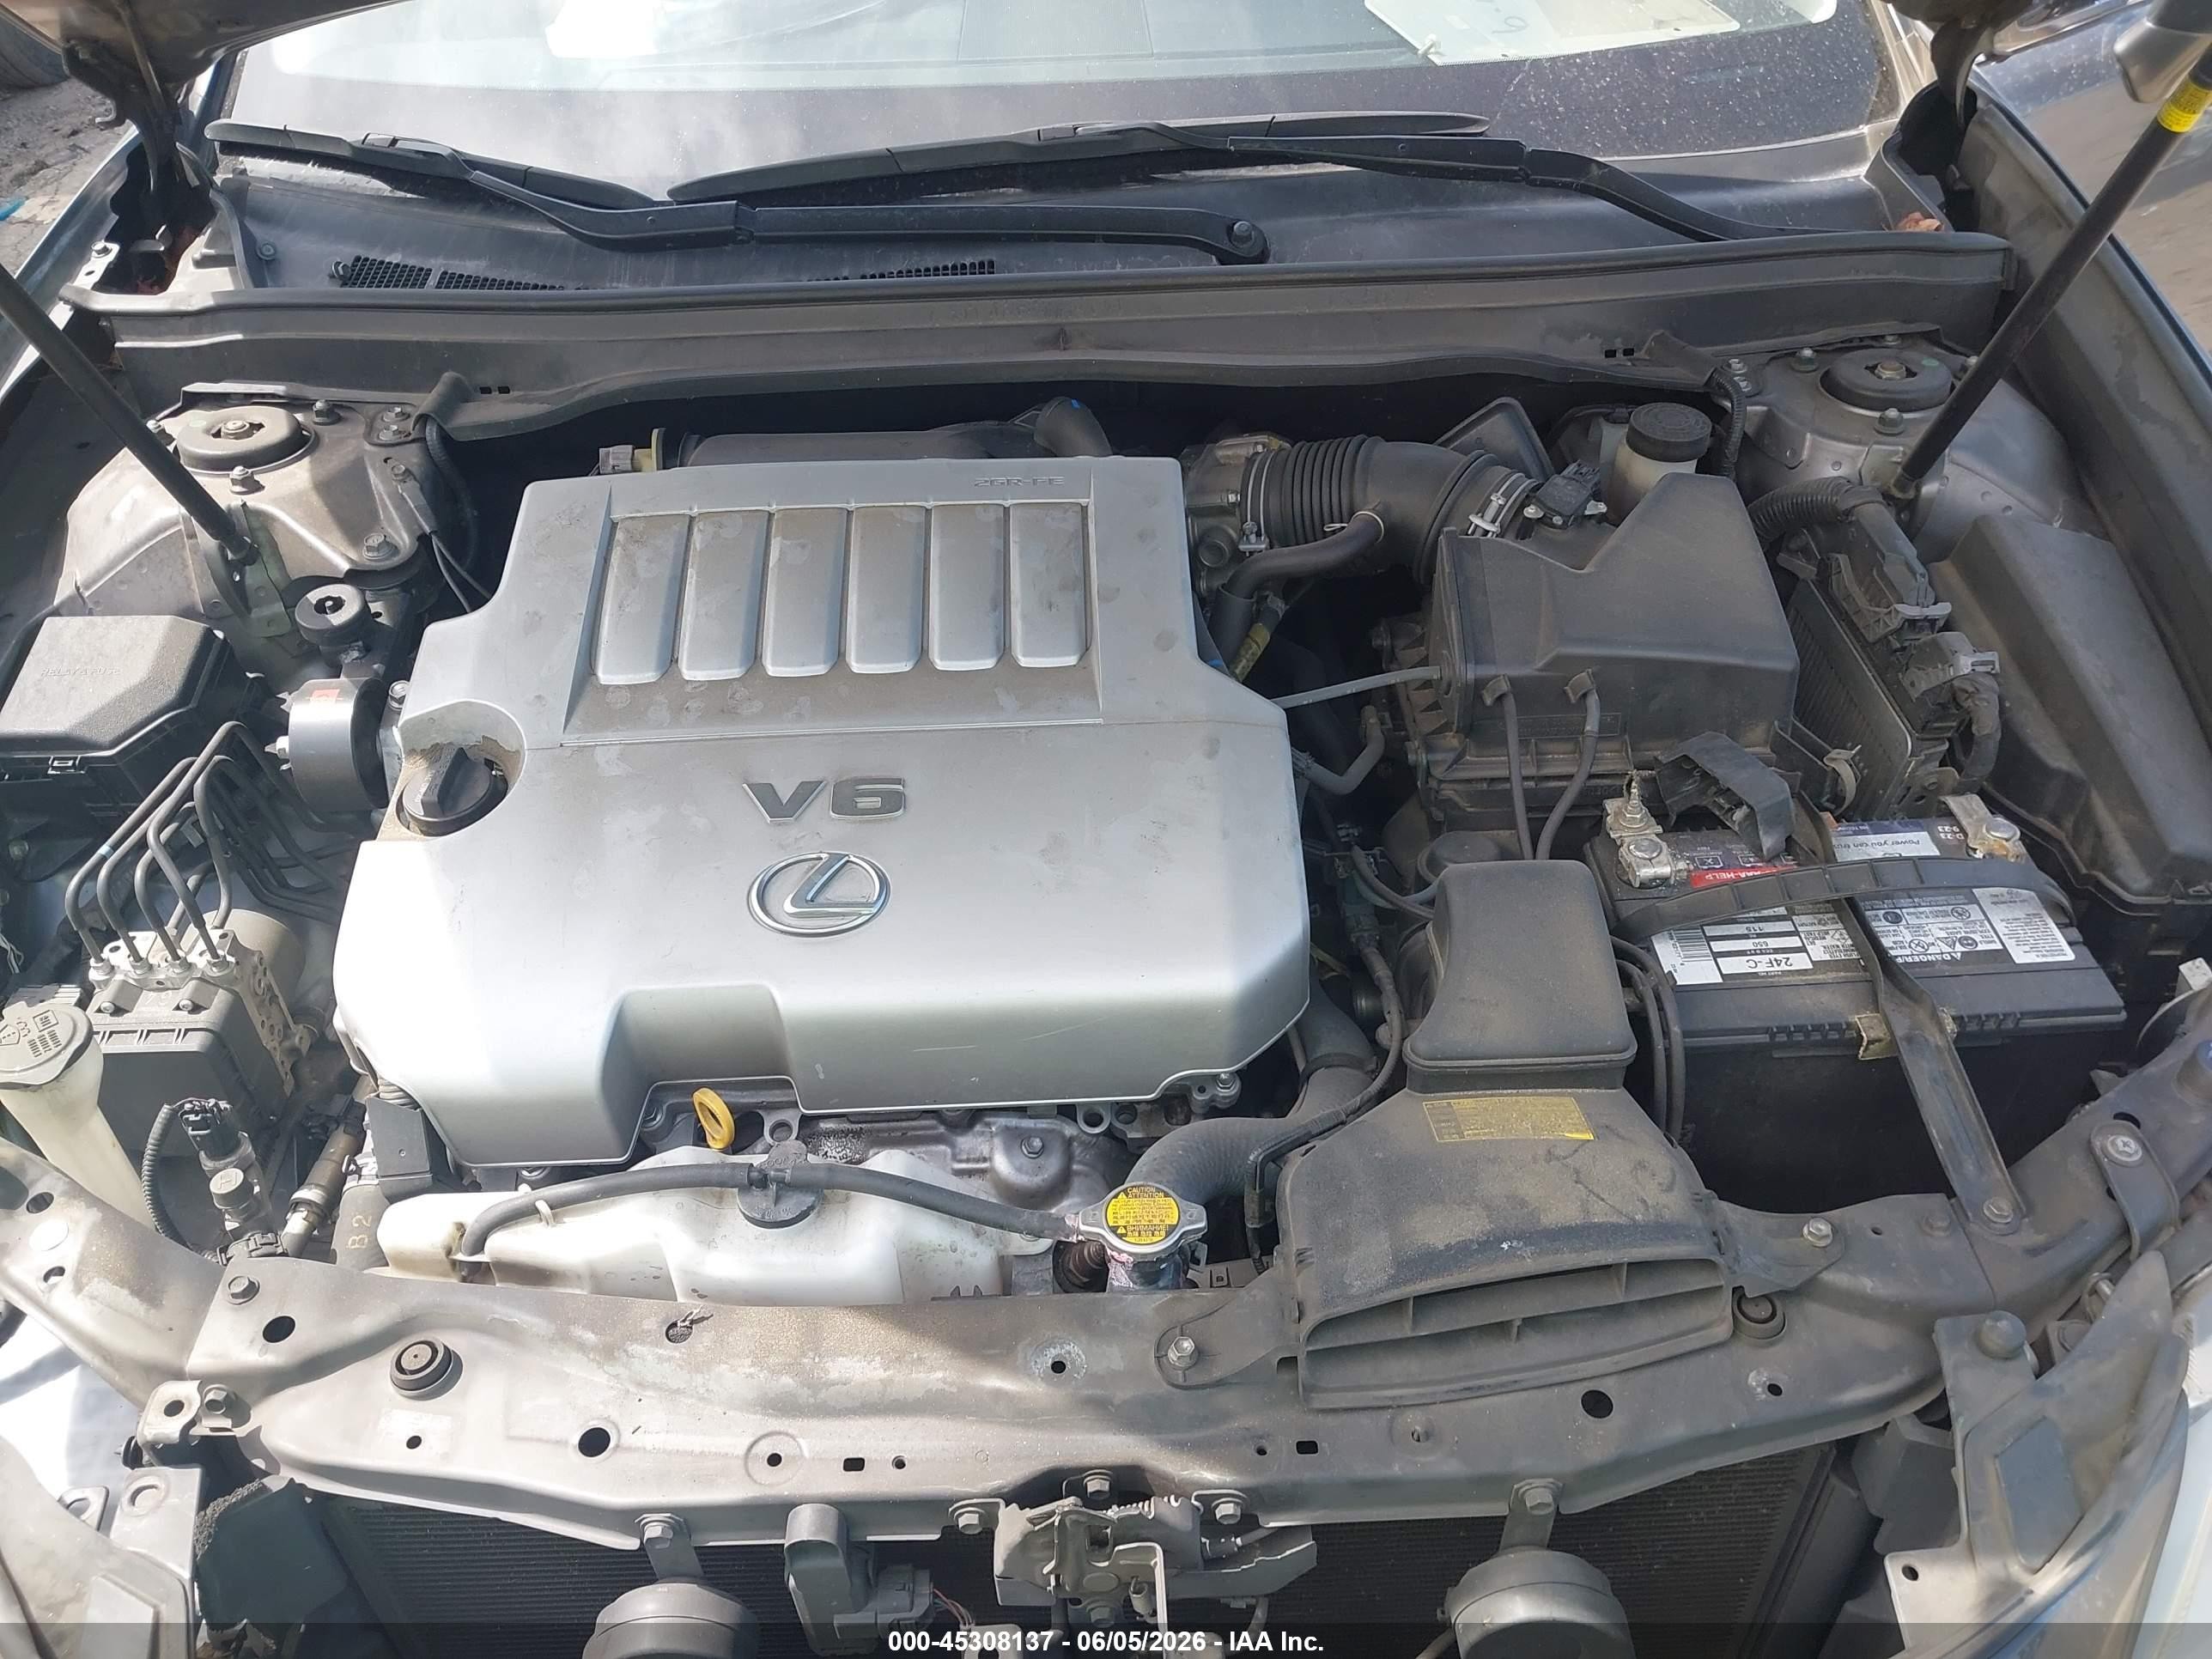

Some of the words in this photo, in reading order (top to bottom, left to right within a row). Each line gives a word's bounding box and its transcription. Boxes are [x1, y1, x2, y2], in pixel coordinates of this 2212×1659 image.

[974, 476, 1065, 487] 2GR-FE
[741, 776, 906, 823] V6
[1745, 957, 1793, 969] 24F-C
[1894, 953, 1951, 963] DANGER/P
